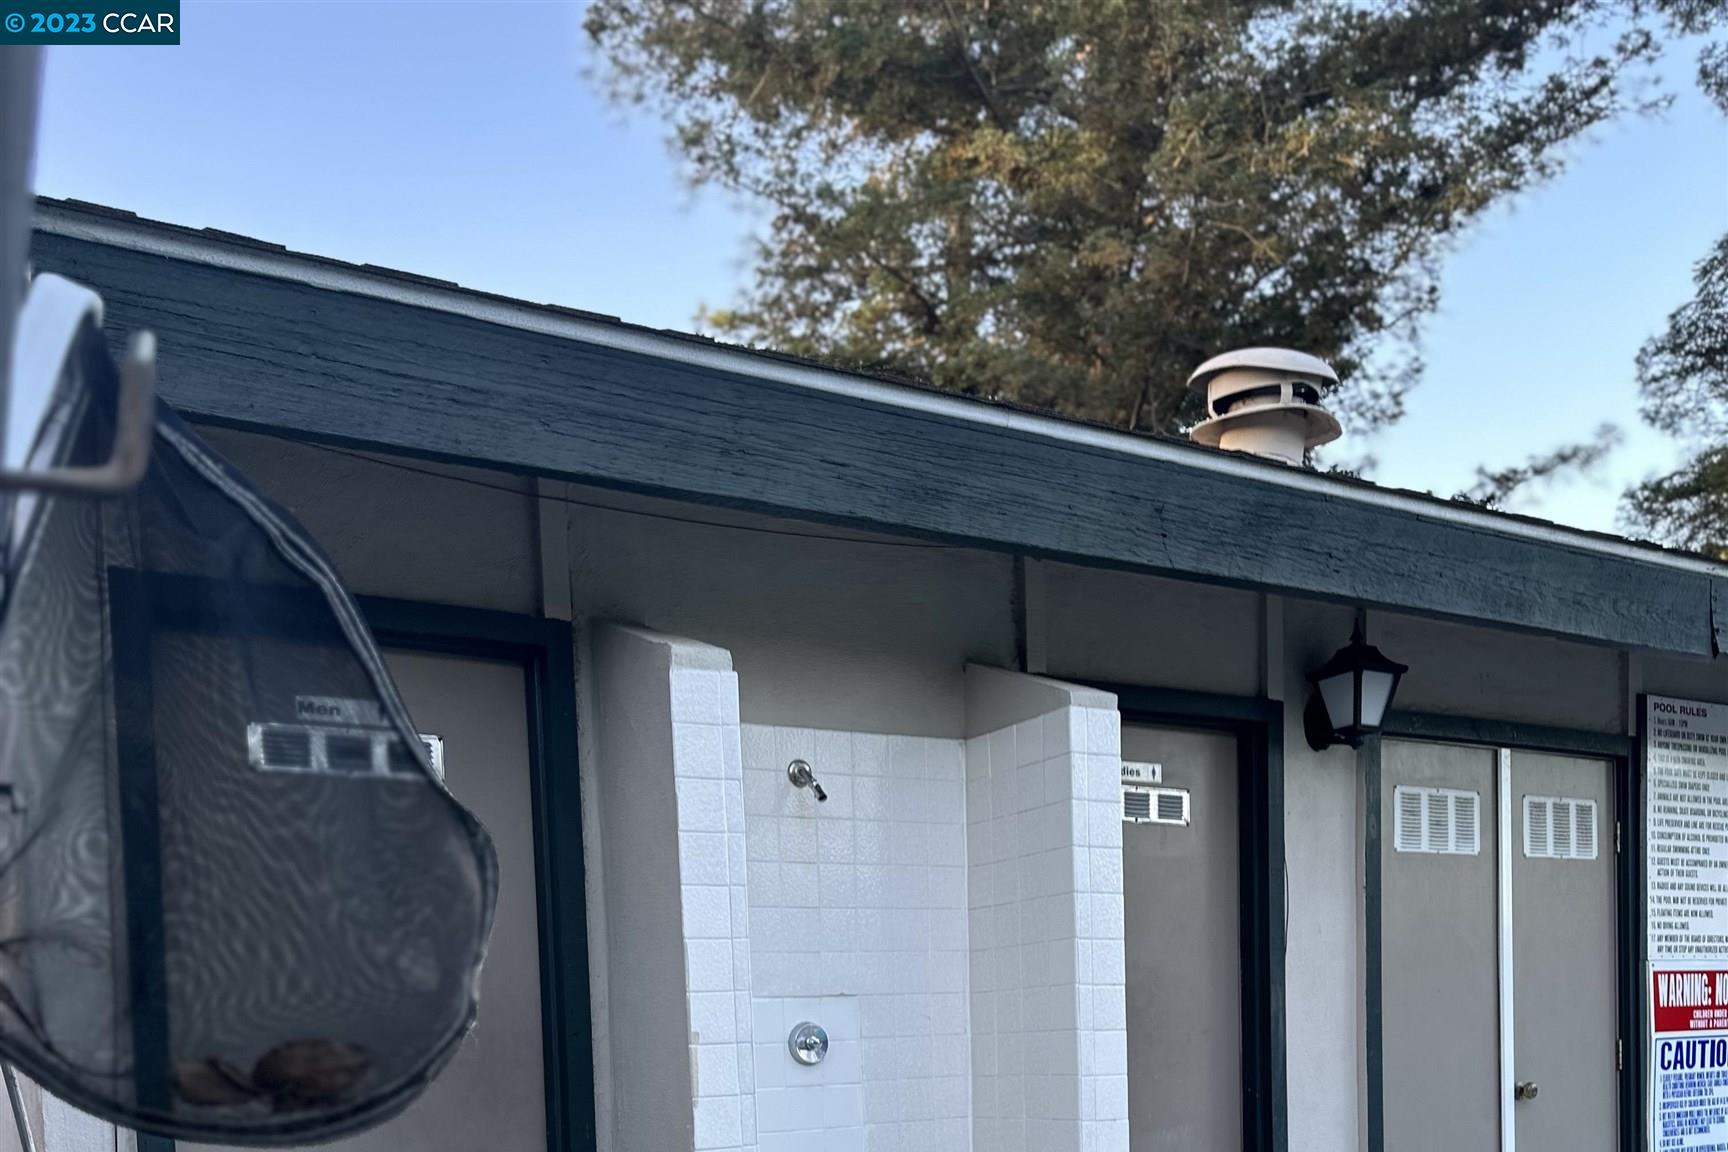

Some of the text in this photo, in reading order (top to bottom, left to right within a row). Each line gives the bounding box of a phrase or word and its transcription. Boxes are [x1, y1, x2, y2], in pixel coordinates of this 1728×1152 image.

[299, 701, 341, 716] Men
[1654, 702, 1707, 717] POOL RULES
[1121, 765, 1141, 777] dies
[1658, 972, 1728, 1008] WARNING: NO
[1693, 1009, 1727, 1018] CHILDREN UNDER
[1690, 1019, 1708, 1029] WITHOUT
[1660, 1039, 1728, 1071] CAUTIO
